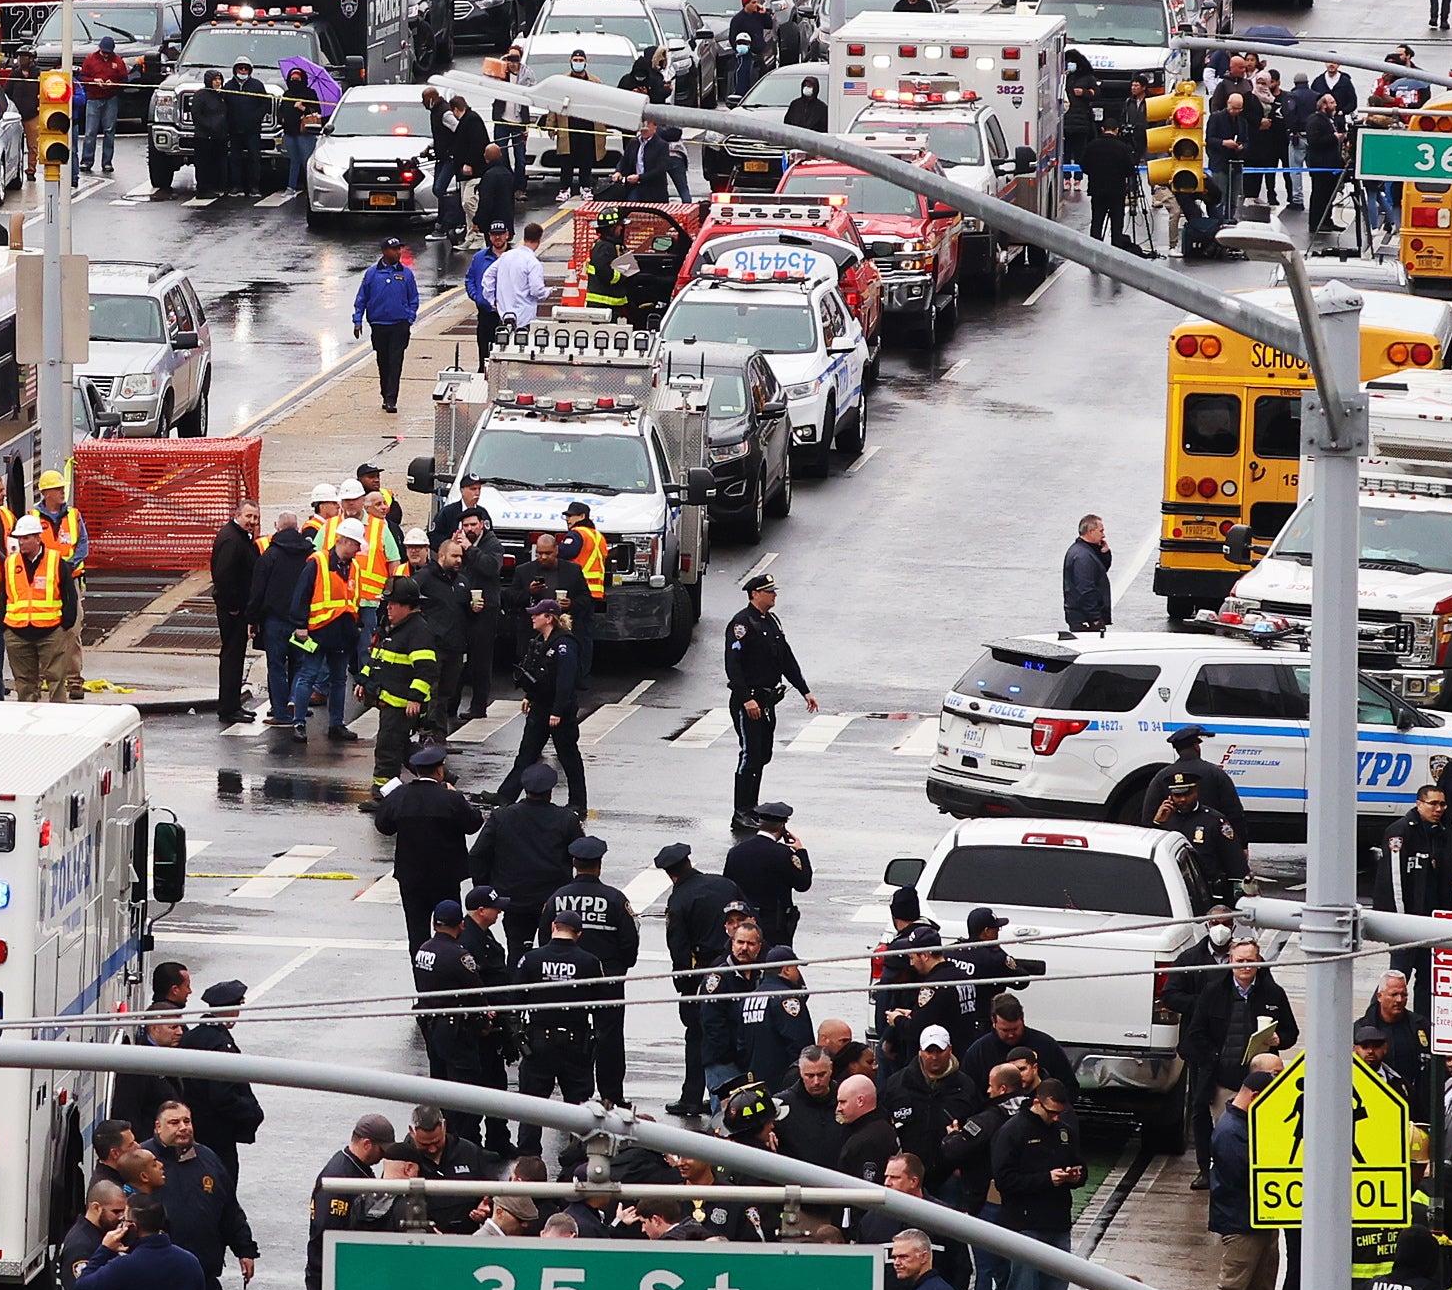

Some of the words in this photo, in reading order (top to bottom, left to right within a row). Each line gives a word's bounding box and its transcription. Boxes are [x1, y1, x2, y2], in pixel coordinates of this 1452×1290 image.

[997, 86, 1024, 95] 3822
[1100, 720, 1120, 731] 4627
[1138, 720, 1150, 731] TD
[1152, 721, 1161, 731] 34
[542, 961, 577, 976] NYPD
[330, 1198, 350, 1210] FBI
